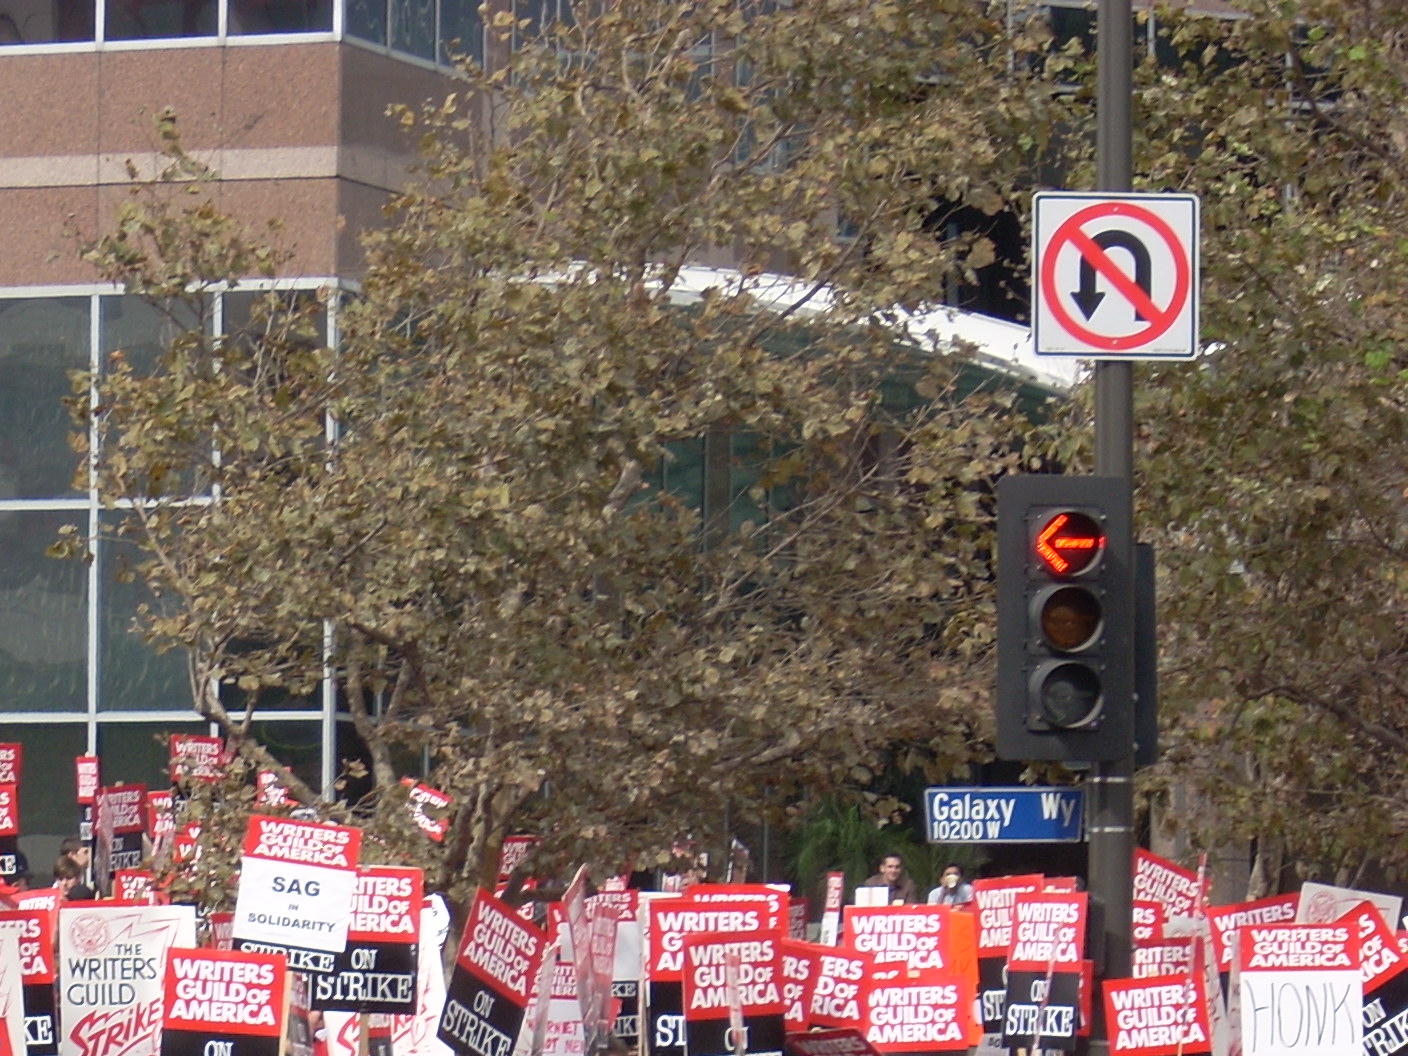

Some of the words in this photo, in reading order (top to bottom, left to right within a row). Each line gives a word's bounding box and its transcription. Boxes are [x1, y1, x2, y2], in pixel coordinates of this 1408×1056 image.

[933, 793, 1015, 827] Galaxy
[1041, 793, 1075, 827] Wy
[260, 821, 350, 844] WRITERS
[933, 821, 984, 839] 10200
[987, 821, 1001, 839] W
[260, 834, 323, 851] GUILD
[254, 845, 348, 867] AMERICA
[272, 877, 321, 896] SAG
[1134, 874, 1177, 902] GUILD
[1137, 857, 1200, 897] WRITERS
[248, 913, 336, 933] SOLIDARITY
[657, 912, 758, 932] WRITERS
[852, 914, 940, 934] WRITERS
[1018, 903, 1079, 923] WRITERS
[1215, 903, 1294, 931] WRITERS
[479, 901, 537, 955] WRITERS
[1059, 927, 1075, 941] OF
[1251, 928, 1349, 941] WRITERS
[115, 944, 142, 955] THE
[474, 923, 515, 965] GUILD
[515, 956, 530, 972] OF
[855, 934, 916, 952] GUILD
[916, 937, 938, 951] OF
[1254, 941, 1320, 955] GUILD
[68, 958, 157, 981] WRITERS
[351, 949, 378, 970] ON
[464, 943, 526, 996] AMERICA
[1249, 955, 1351, 968] AMERICA
[172, 959, 274, 985] WRITERS
[754, 968, 774, 983] OF
[67, 983, 135, 1006] GUILD
[176, 981, 246, 1001] GUILD
[246, 989, 270, 1005] OF
[316, 973, 413, 1003] STRIKE
[869, 986, 957, 1007] WRITERS
[1111, 982, 1197, 1010] WRITERS
[169, 1000, 275, 1025] AMERICA
[474, 990, 495, 1018] ON
[1362, 999, 1387, 1026] ON
[870, 1006, 934, 1025] GUILD
[1118, 1008, 1178, 1030] GUILD
[1245, 980, 1355, 1053] HONK
[867, 1023, 963, 1044] AMERICA
[796, 1038, 867, 1054] WRITERS
